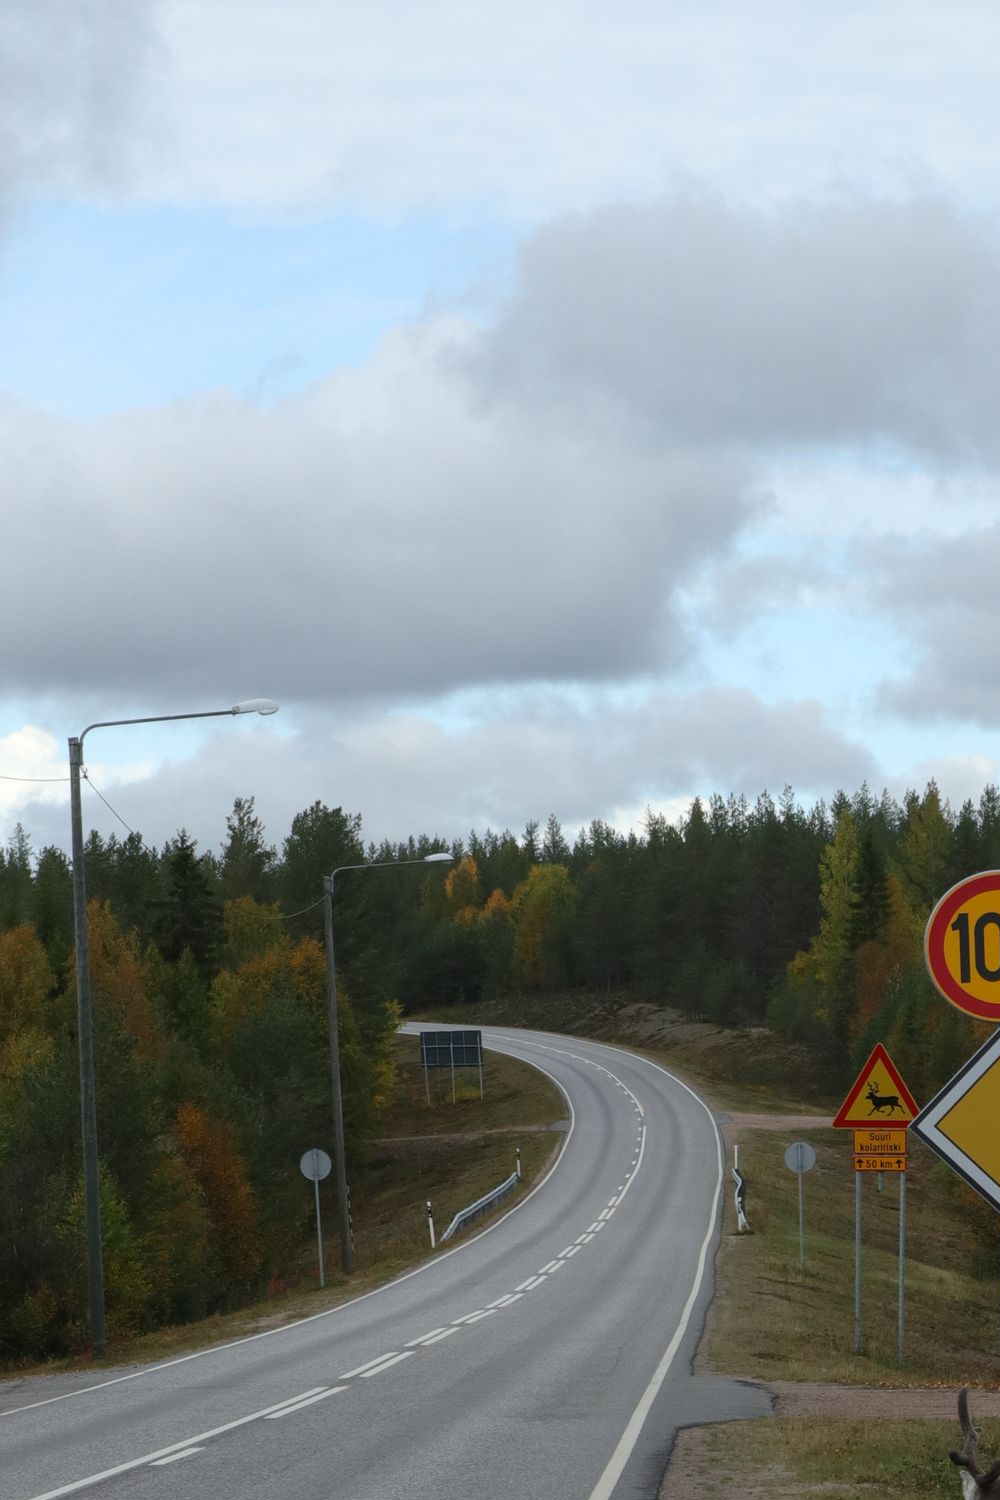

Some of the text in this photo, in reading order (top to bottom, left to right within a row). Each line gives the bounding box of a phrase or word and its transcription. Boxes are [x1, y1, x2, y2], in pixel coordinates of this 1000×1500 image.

[869, 1132, 891, 1141] Suuri
[866, 1160, 893, 1168] 50 km
